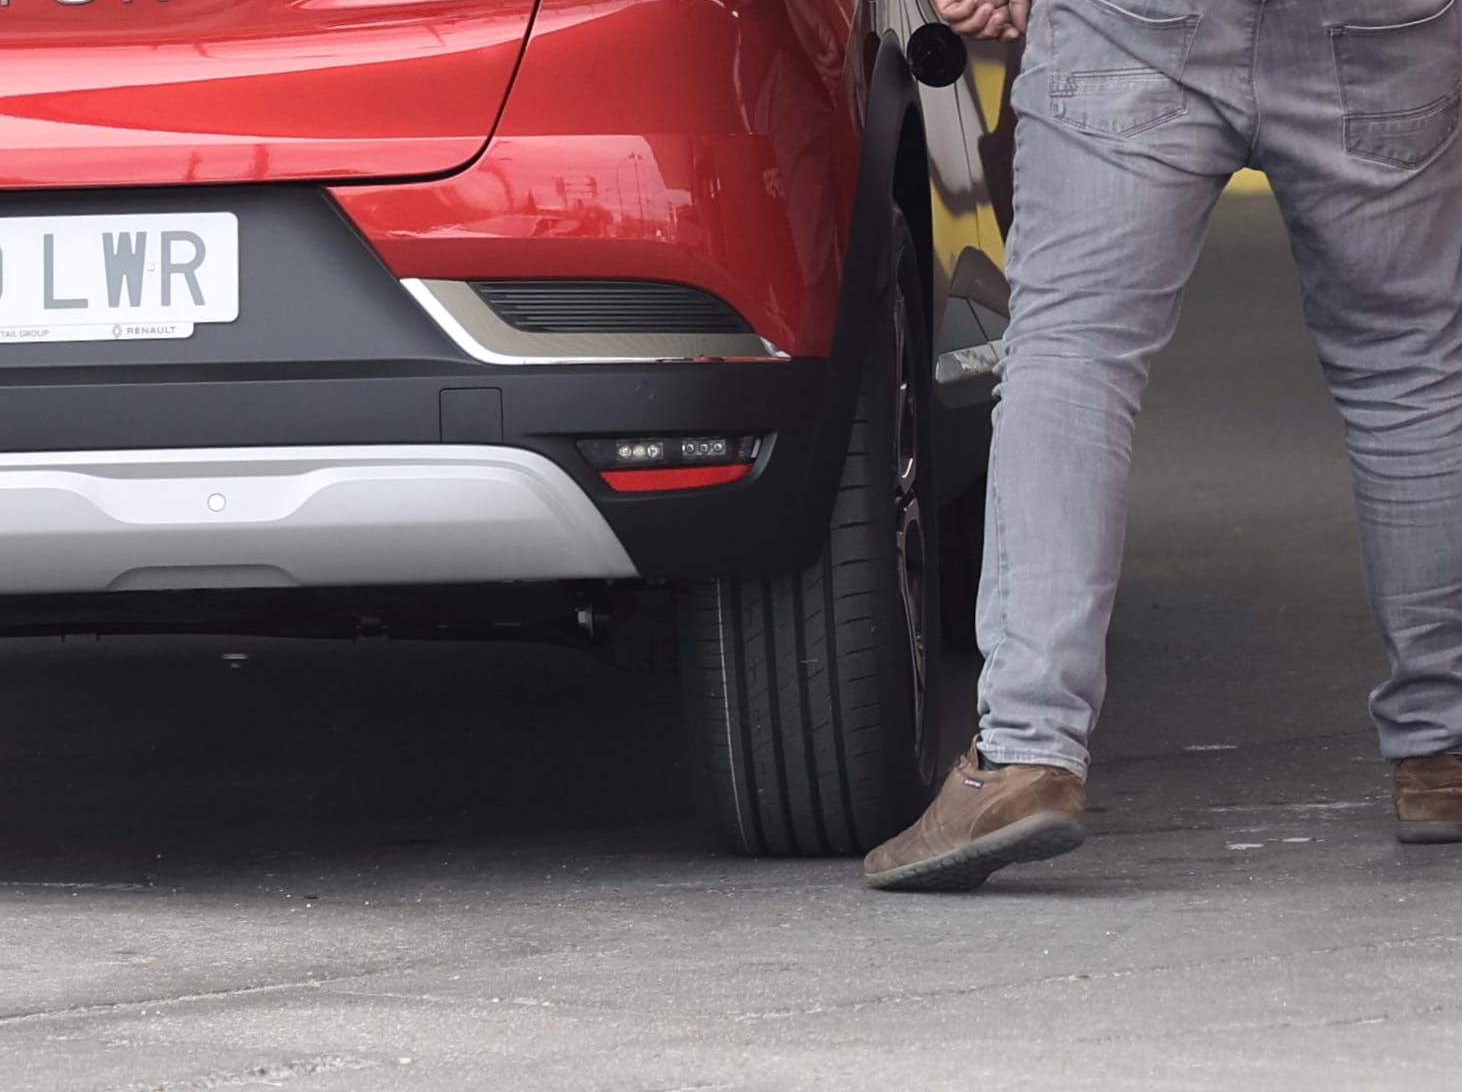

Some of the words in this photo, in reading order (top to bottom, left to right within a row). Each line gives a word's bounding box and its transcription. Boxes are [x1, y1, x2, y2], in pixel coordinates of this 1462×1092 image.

[43, 230, 206, 310] LWR
[19, 329, 49, 338] GROUP
[127, 326, 176, 335] RENAULT
